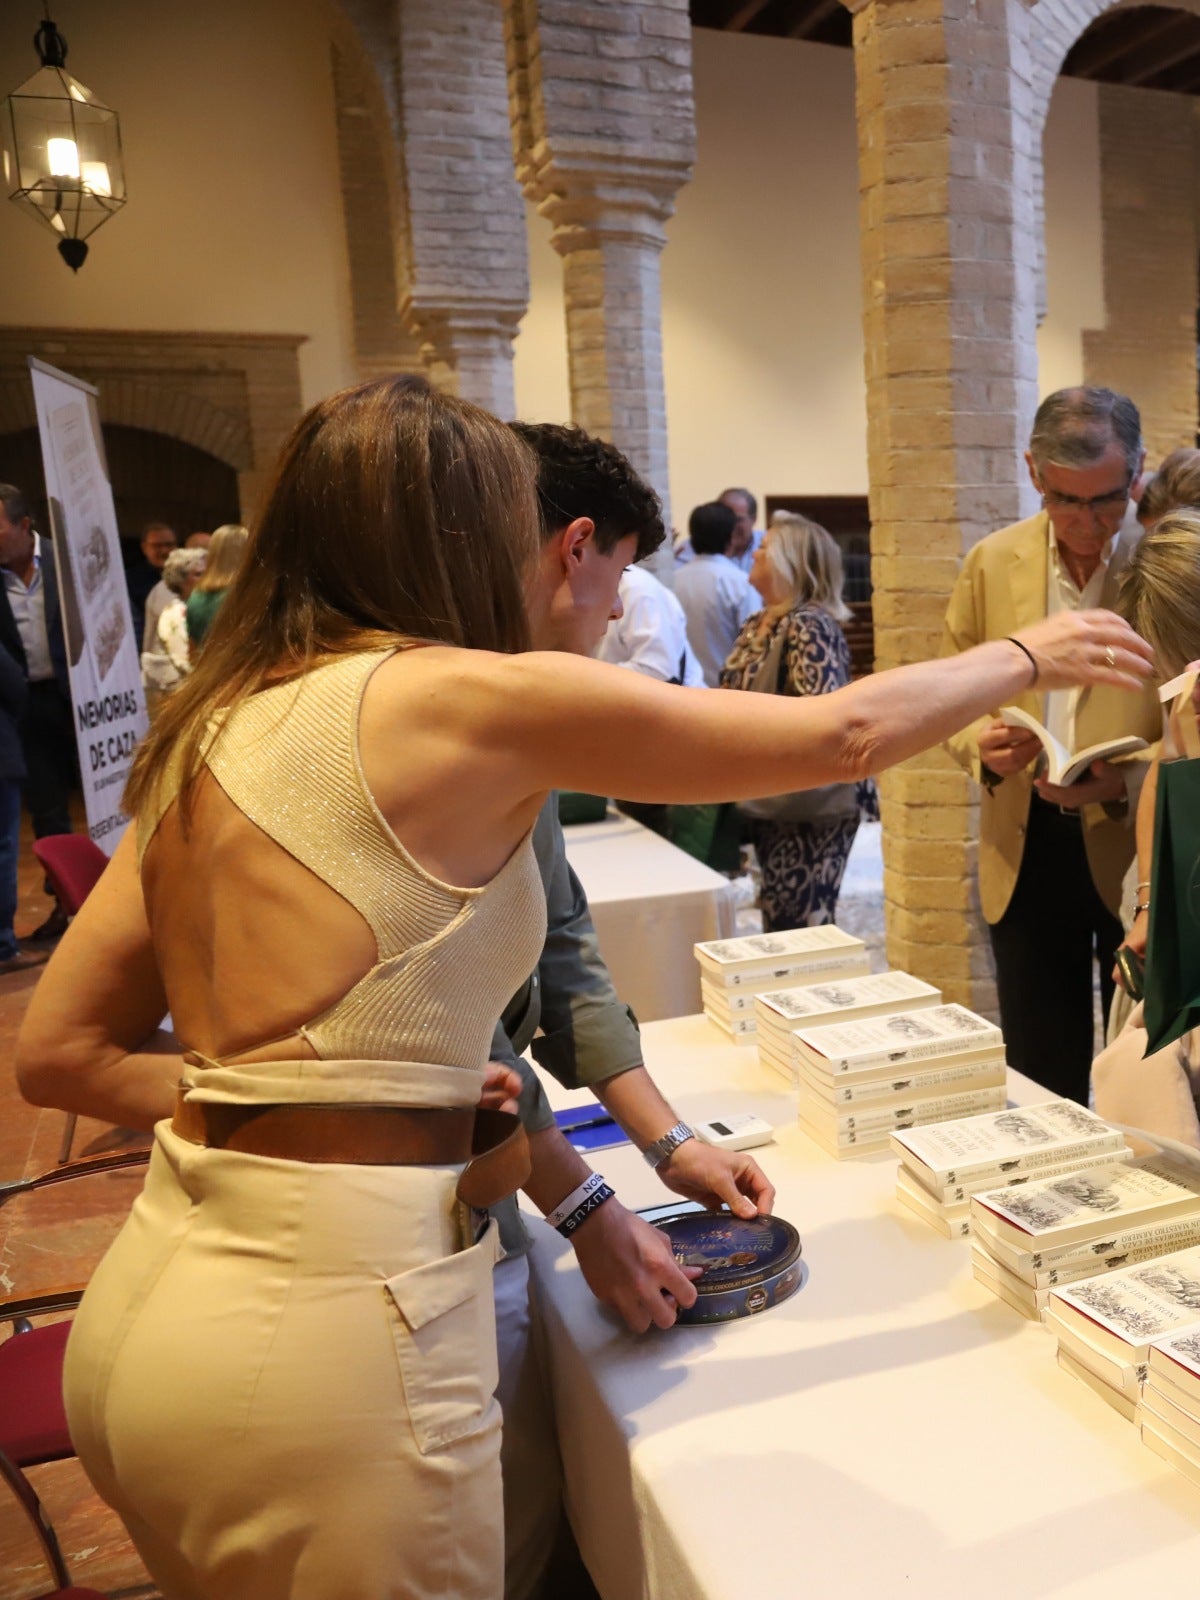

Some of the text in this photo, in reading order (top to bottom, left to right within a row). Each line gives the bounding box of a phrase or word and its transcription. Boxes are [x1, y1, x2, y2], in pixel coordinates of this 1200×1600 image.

[90, 741, 107, 772] DE
[566, 1186, 611, 1230] YUXUS
[1121, 1231, 1153, 1242] ARMERO
[1154, 1223, 1190, 1236] MAESTRO
